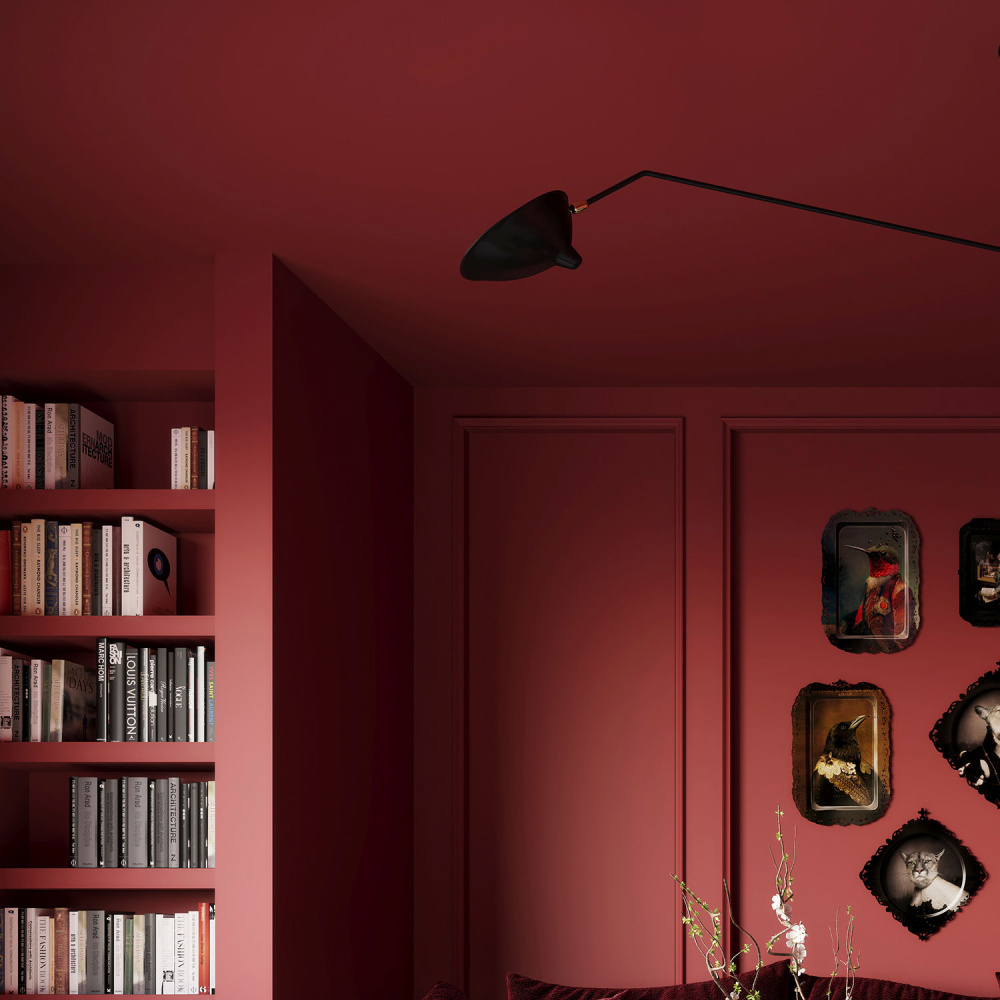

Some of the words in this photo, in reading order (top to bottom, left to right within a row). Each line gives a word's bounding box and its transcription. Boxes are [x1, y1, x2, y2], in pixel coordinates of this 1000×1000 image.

[68, 675, 94, 694] DAYS
[126, 655, 136, 686] LOUIS
[126, 688, 136, 735] VUITTON
